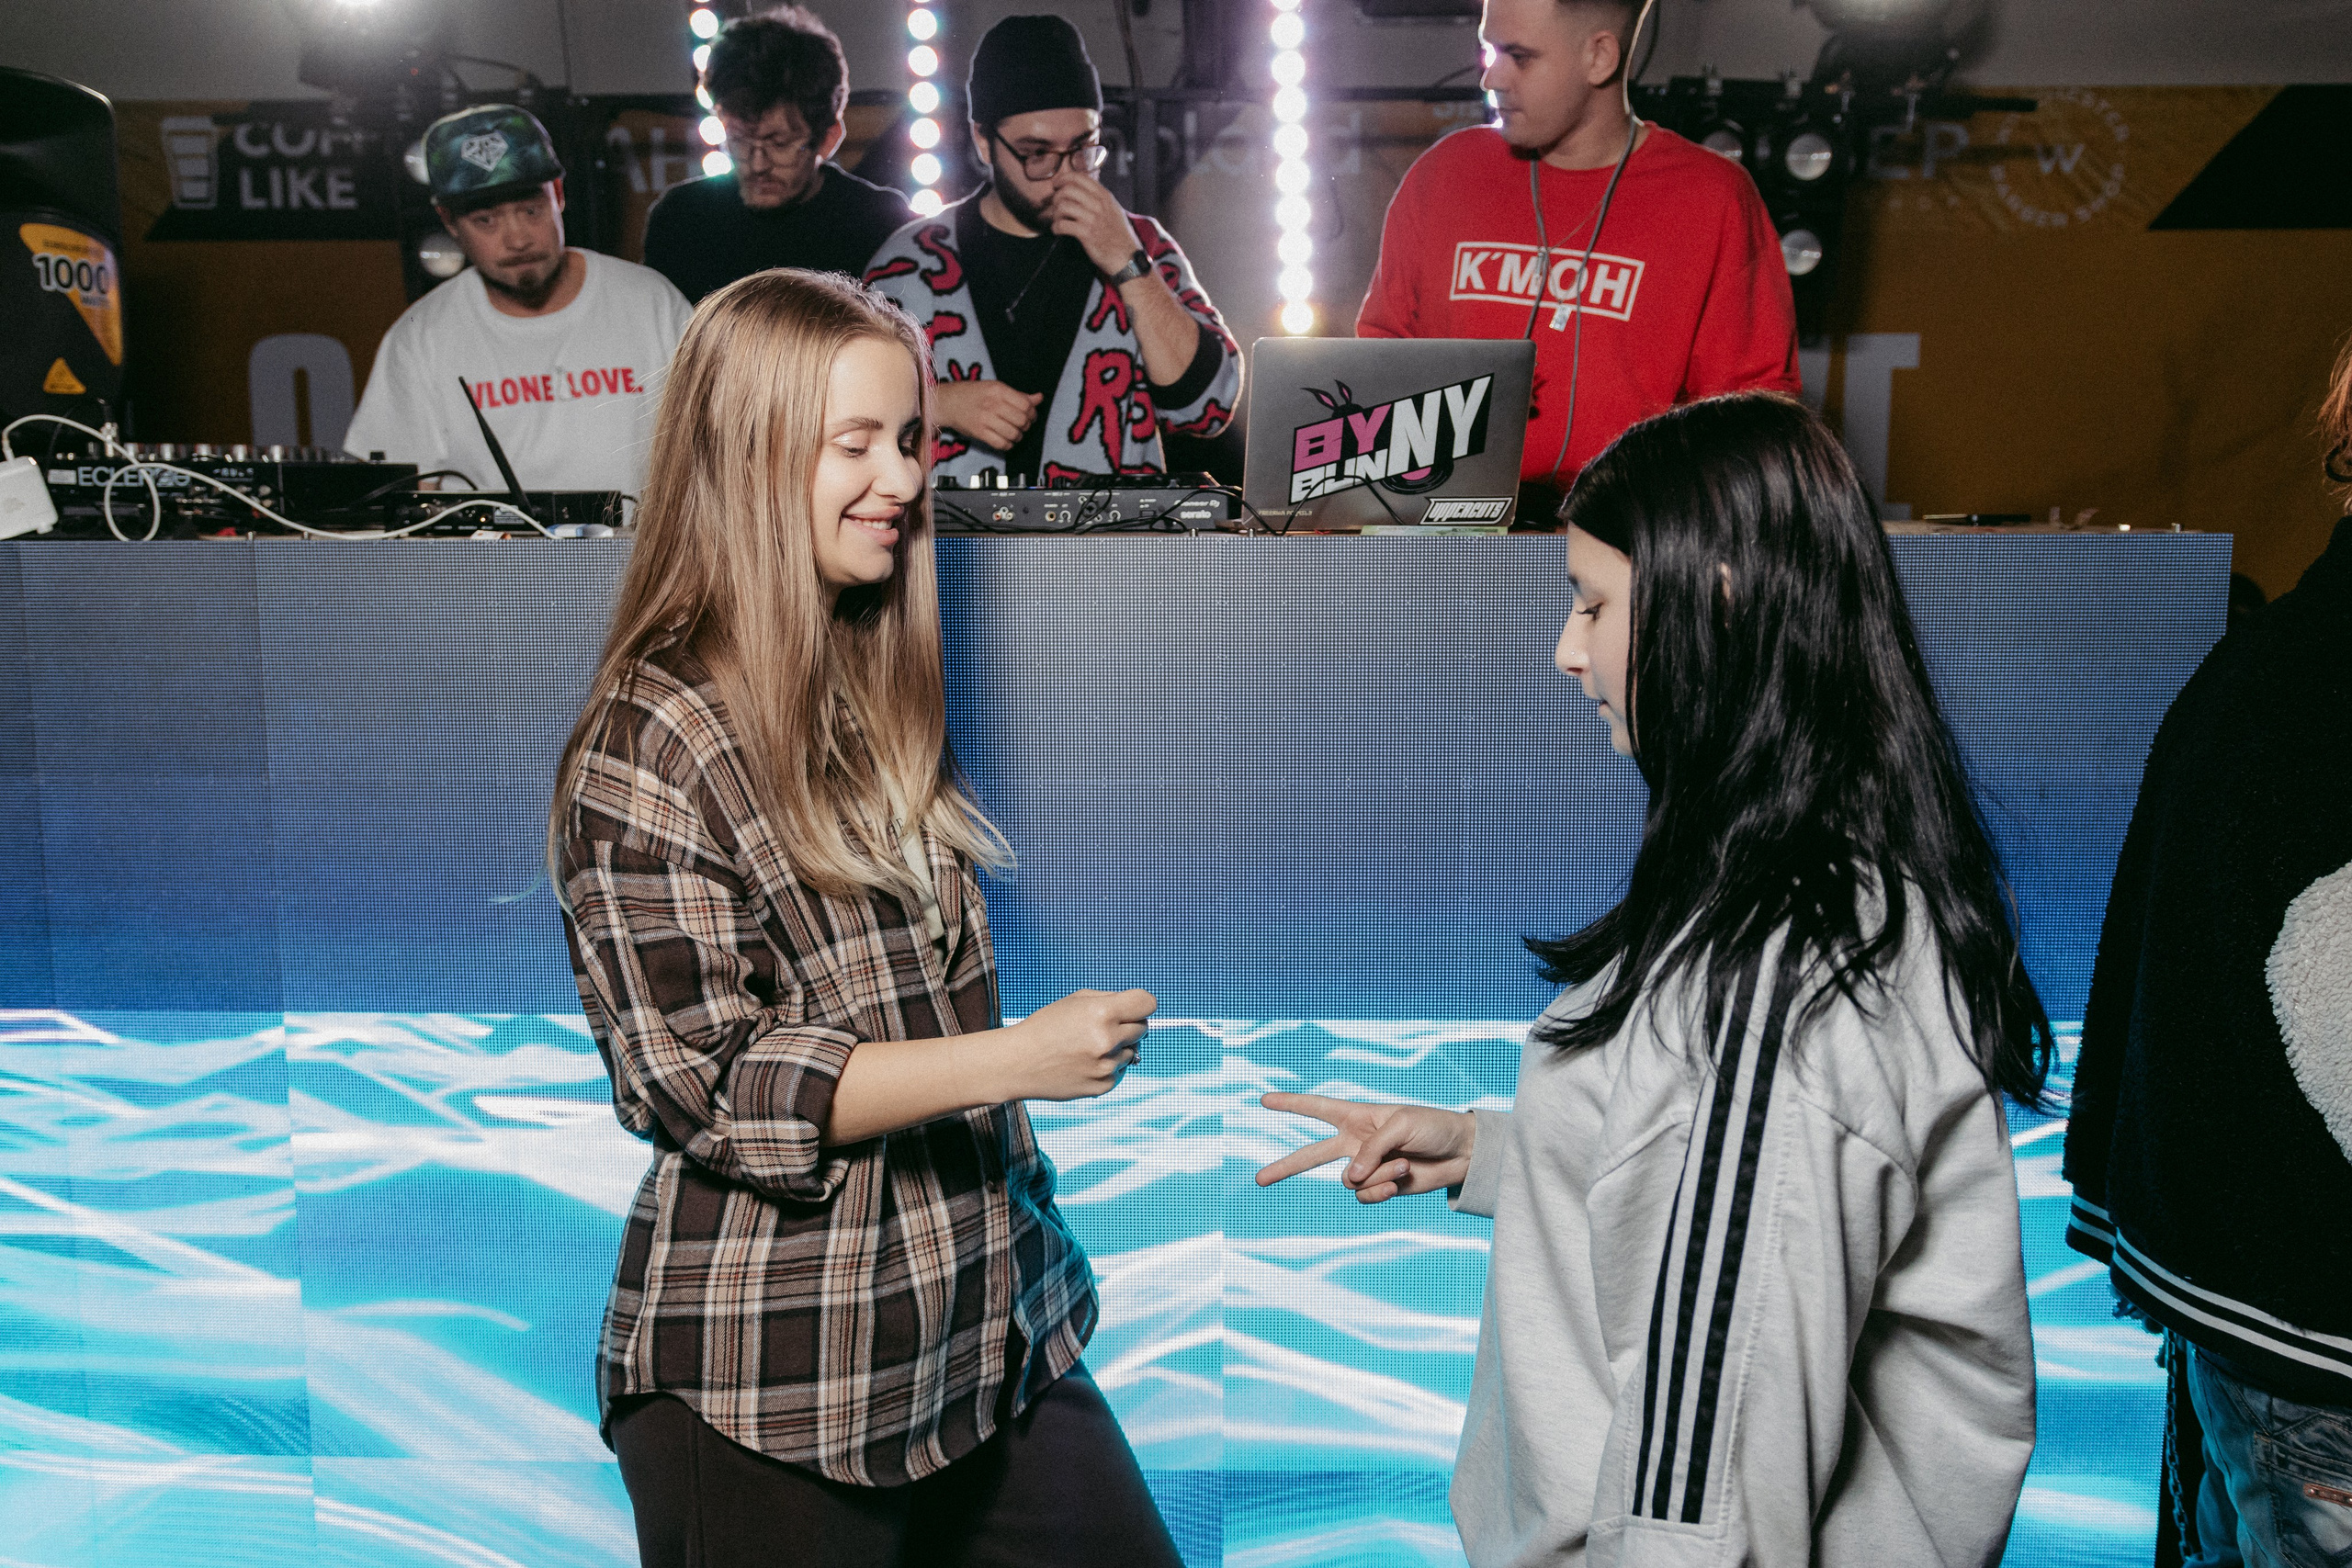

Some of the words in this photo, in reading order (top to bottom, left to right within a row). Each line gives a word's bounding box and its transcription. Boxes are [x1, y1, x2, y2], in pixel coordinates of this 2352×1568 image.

[238, 166, 359, 210] LIKE
[33, 253, 110, 295] 1000
[466, 374, 555, 410] VLONE
[567, 367, 644, 400] LOVE.
